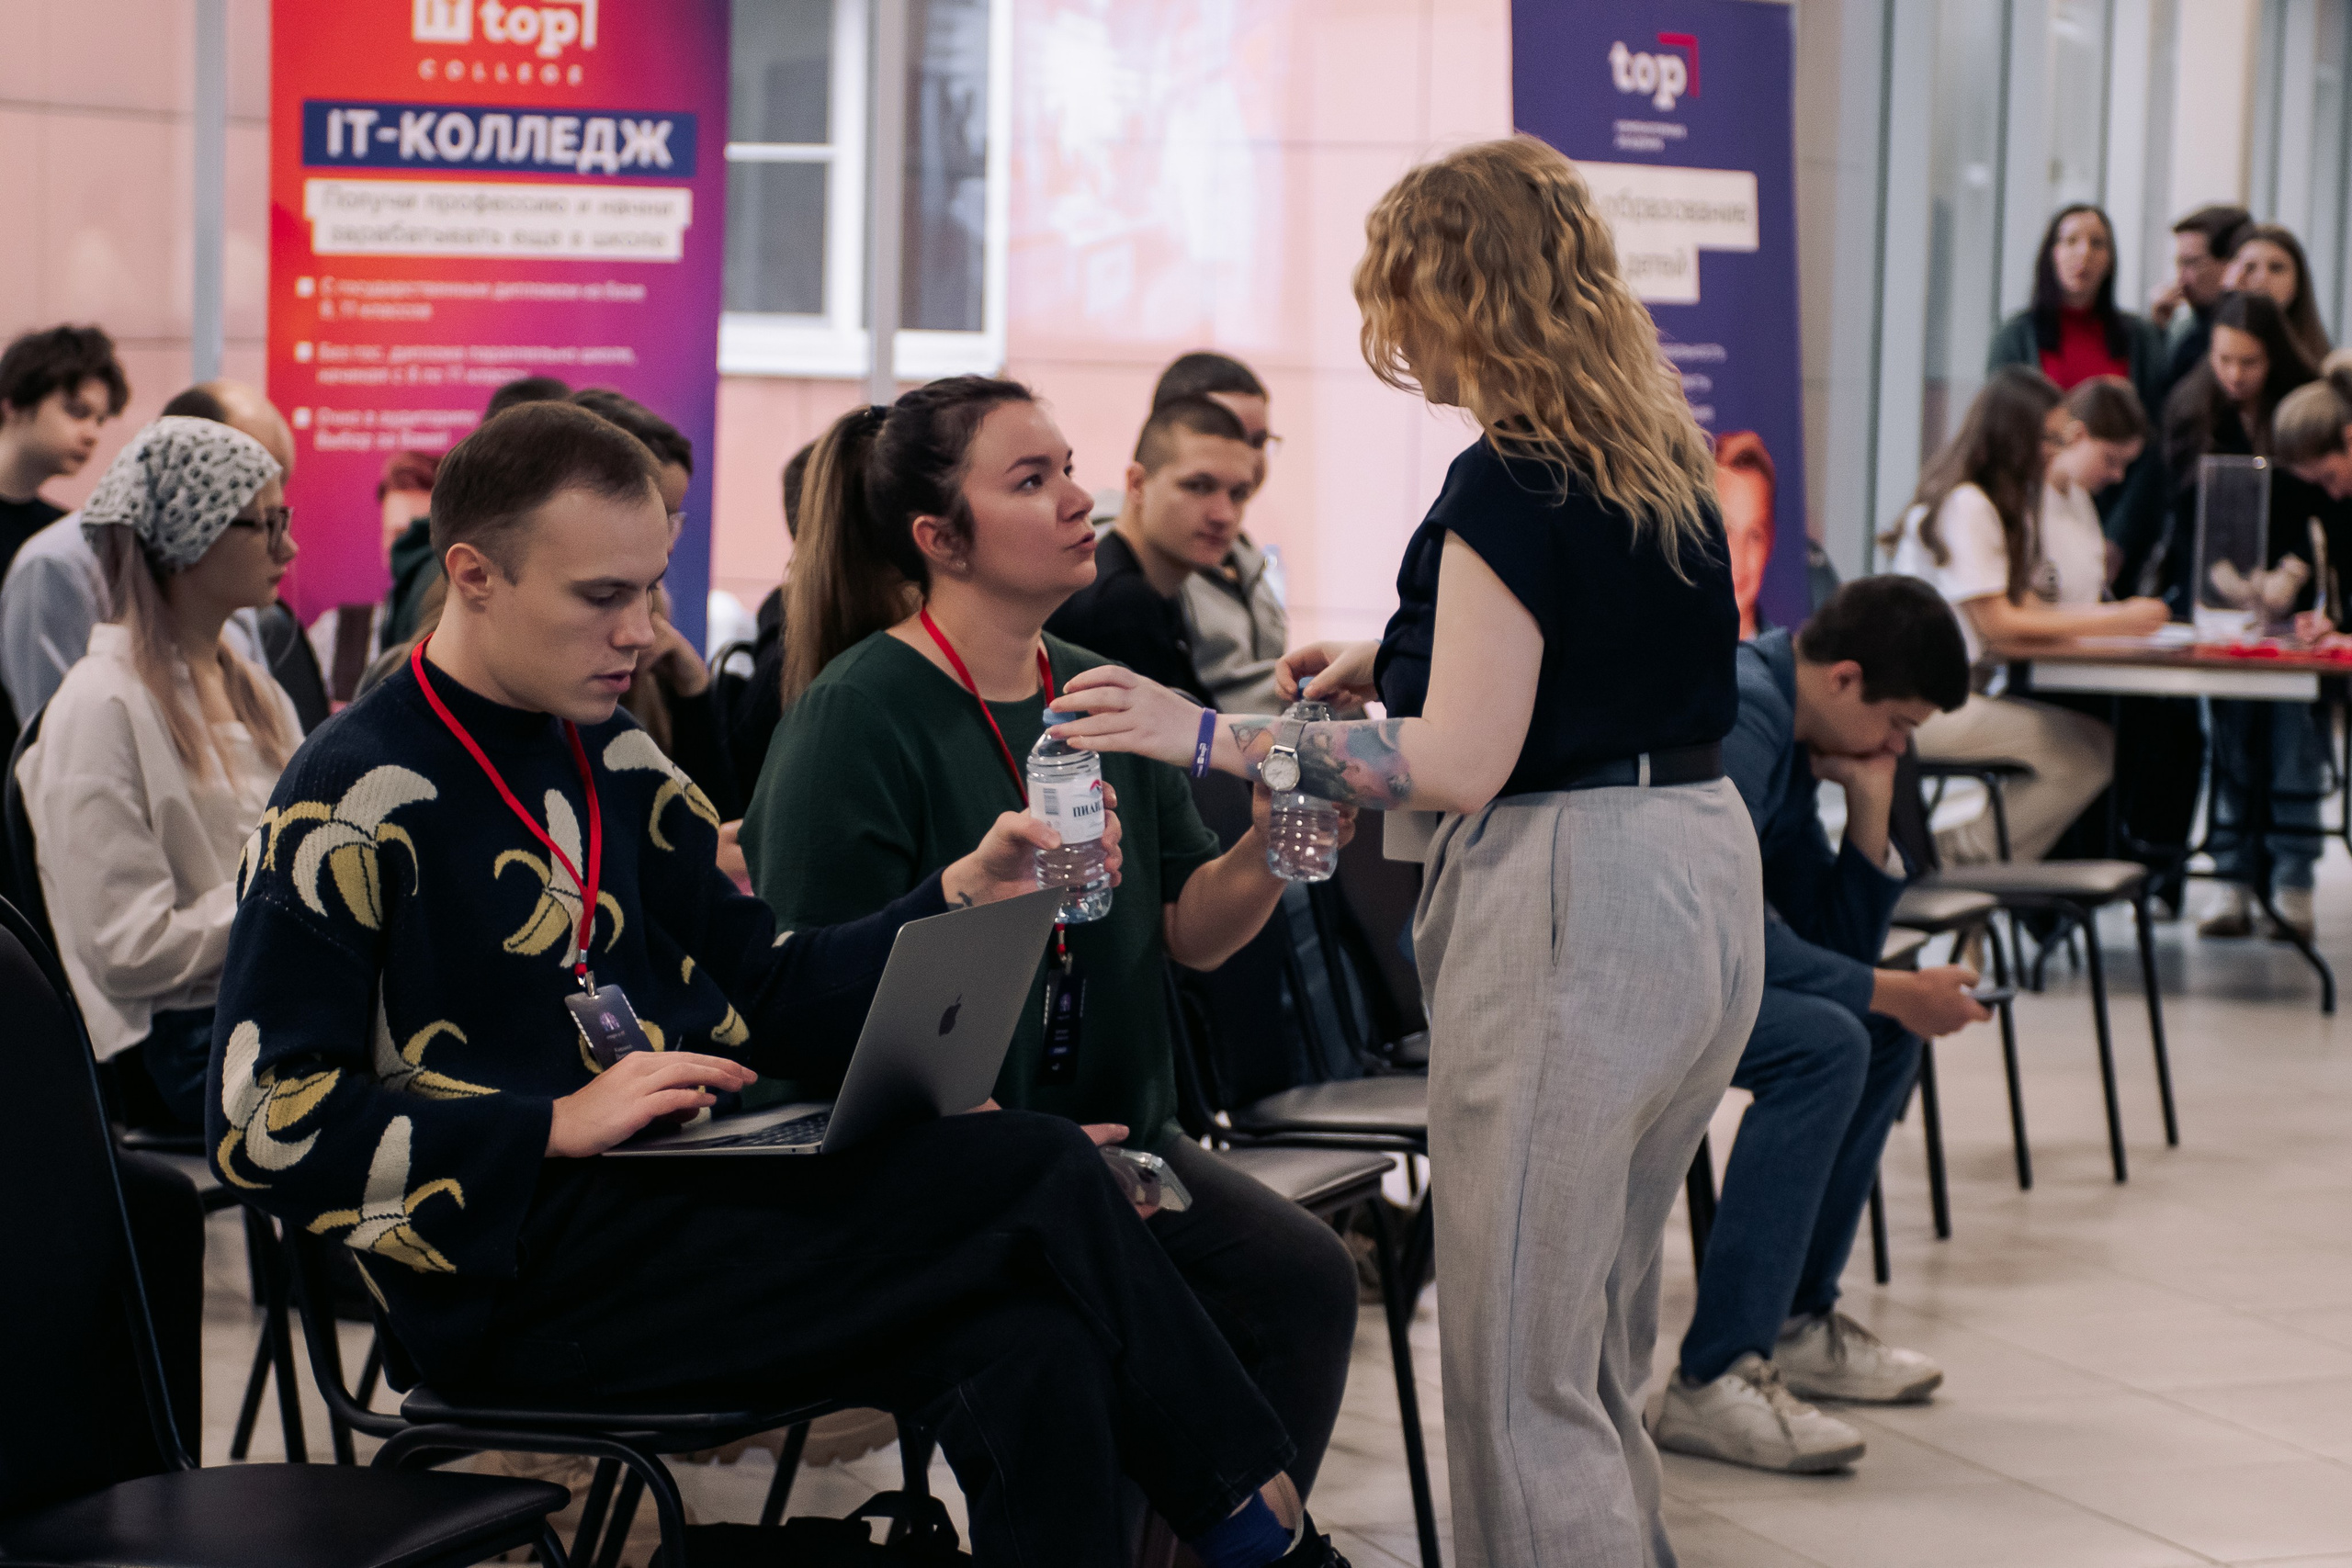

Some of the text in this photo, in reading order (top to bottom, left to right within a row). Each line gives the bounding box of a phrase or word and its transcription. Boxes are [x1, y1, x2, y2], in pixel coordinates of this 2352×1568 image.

[479, 0, 580, 58] top
[417, 57, 584, 86] COLLEGE
[1609, 40, 1687, 111] top
[326, 107, 674, 175] IT-КОЛЛЕДЖ
